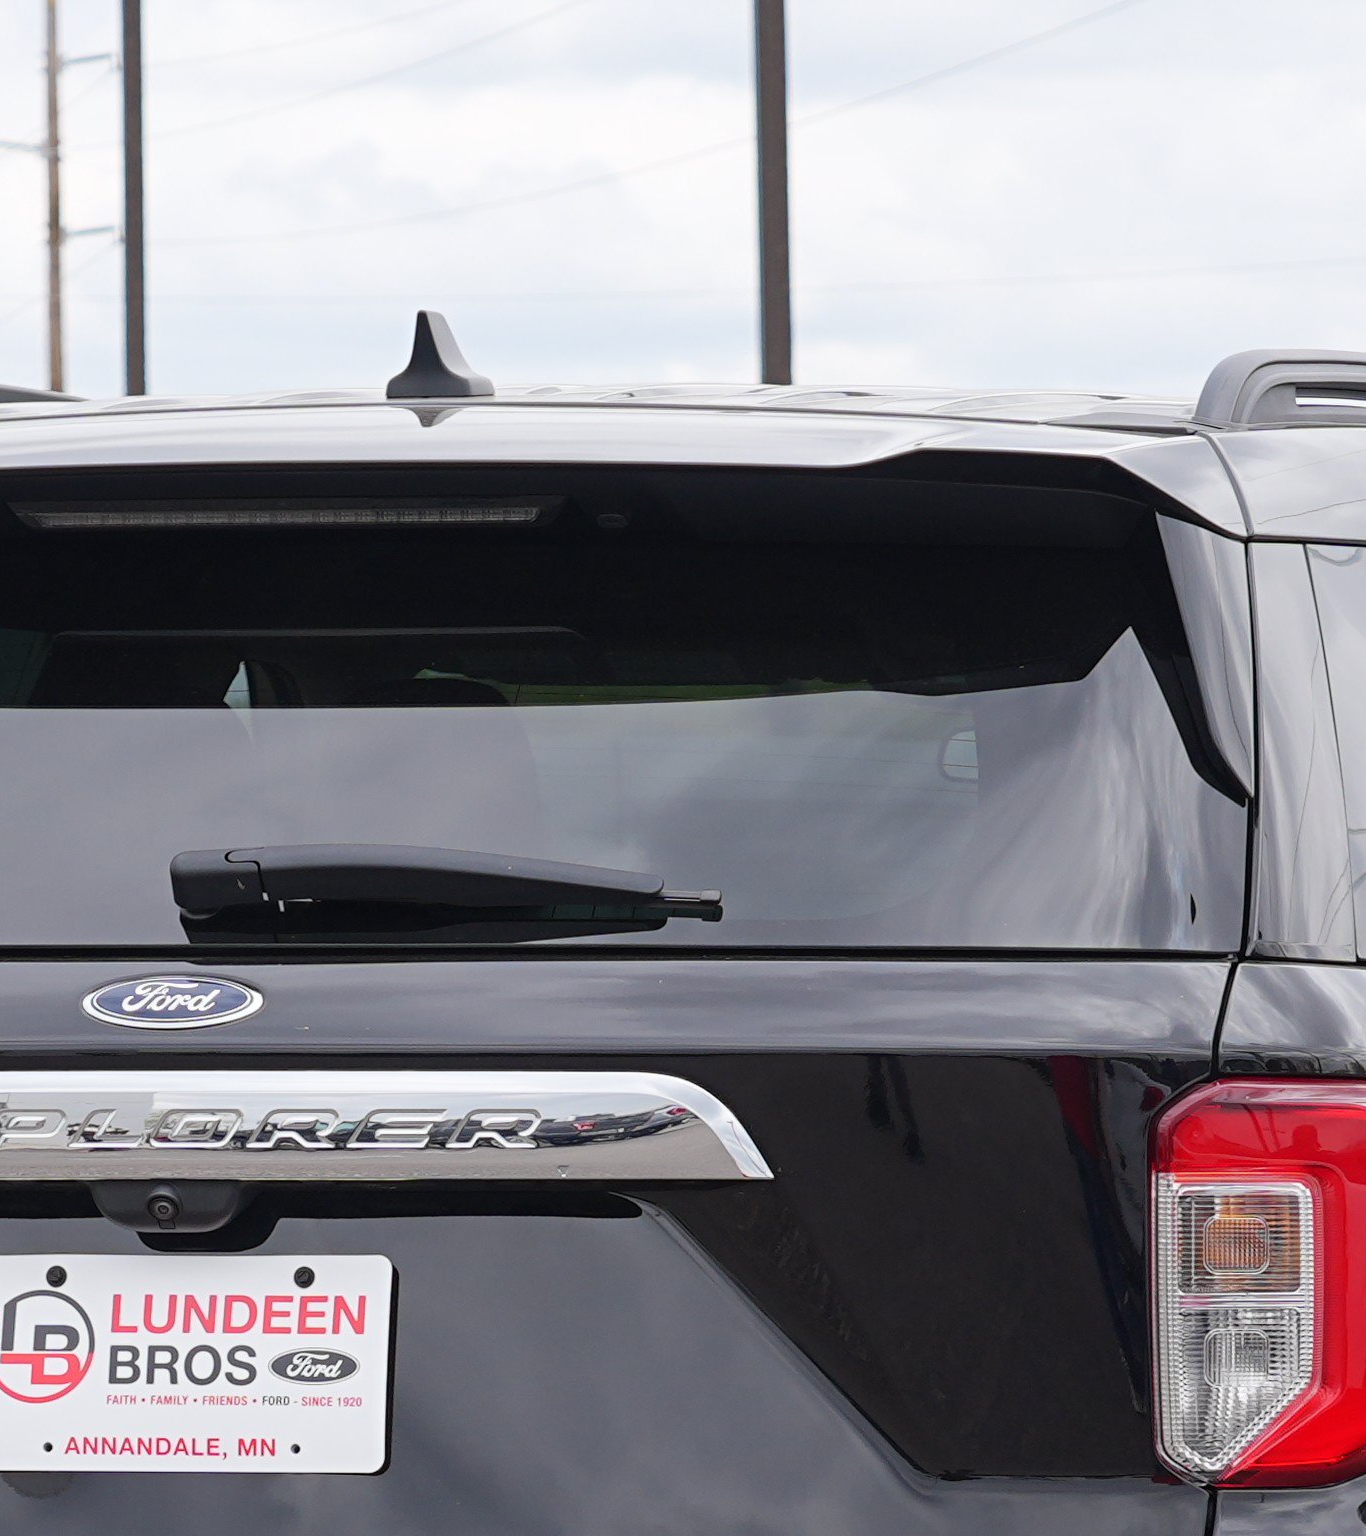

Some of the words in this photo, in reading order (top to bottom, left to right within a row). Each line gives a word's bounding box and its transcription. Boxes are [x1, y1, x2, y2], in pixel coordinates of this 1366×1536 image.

[122, 982, 221, 1012] Ford
[110, 1294, 367, 1335] LUNDEEN
[108, 1345, 257, 1386] BROS
[106, 1394, 137, 1406] FAITH
[150, 1394, 189, 1406] FAMILY
[202, 1395, 248, 1407] FRIENDS
[261, 1395, 291, 1407] FORD
[300, 1395, 333, 1407] SINCE
[337, 1396, 363, 1408] 1920
[64, 1437, 228, 1460] ANNANDALE,
[237, 1438, 276, 1457] MN
